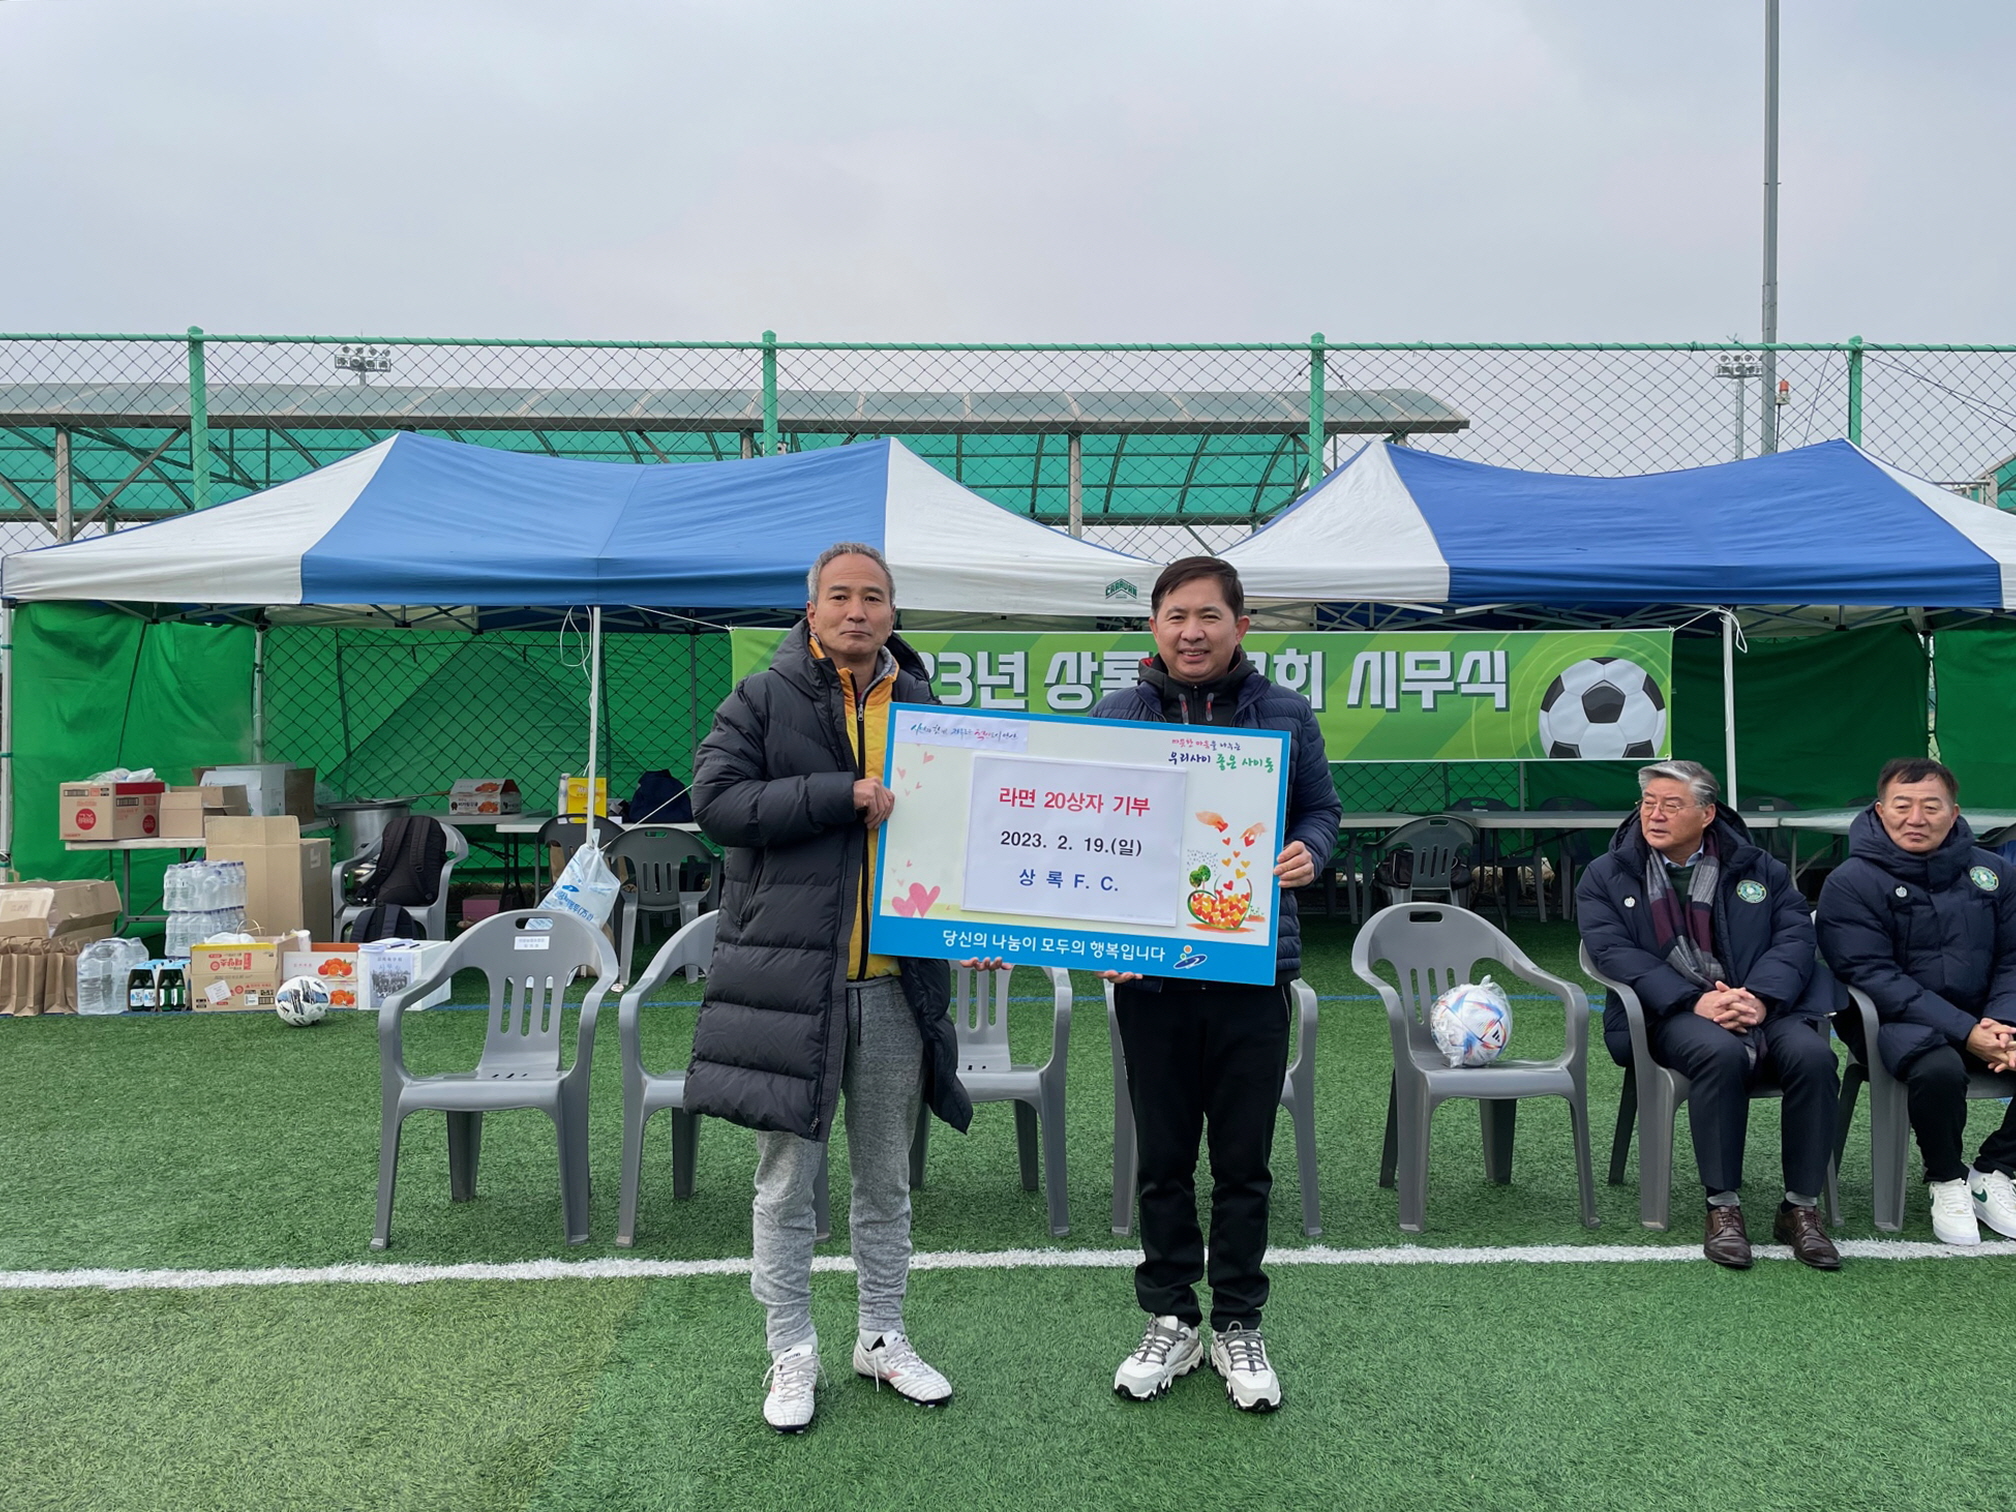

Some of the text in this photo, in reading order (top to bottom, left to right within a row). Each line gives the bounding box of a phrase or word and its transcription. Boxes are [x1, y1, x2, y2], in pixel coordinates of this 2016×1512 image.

[1044, 648, 1324, 711] 상록회
[1346, 650, 1508, 711] 시무식
[1168, 751, 1211, 765] 우리사이
[1216, 753, 1237, 771] 좋은
[999, 787, 1151, 817] 라면 20상자 기부
[1000, 830, 1142, 857] 2023. 2. 19.(일)
[942, 929, 1166, 962] 당신의 나눔이 모두의 행복입니다
